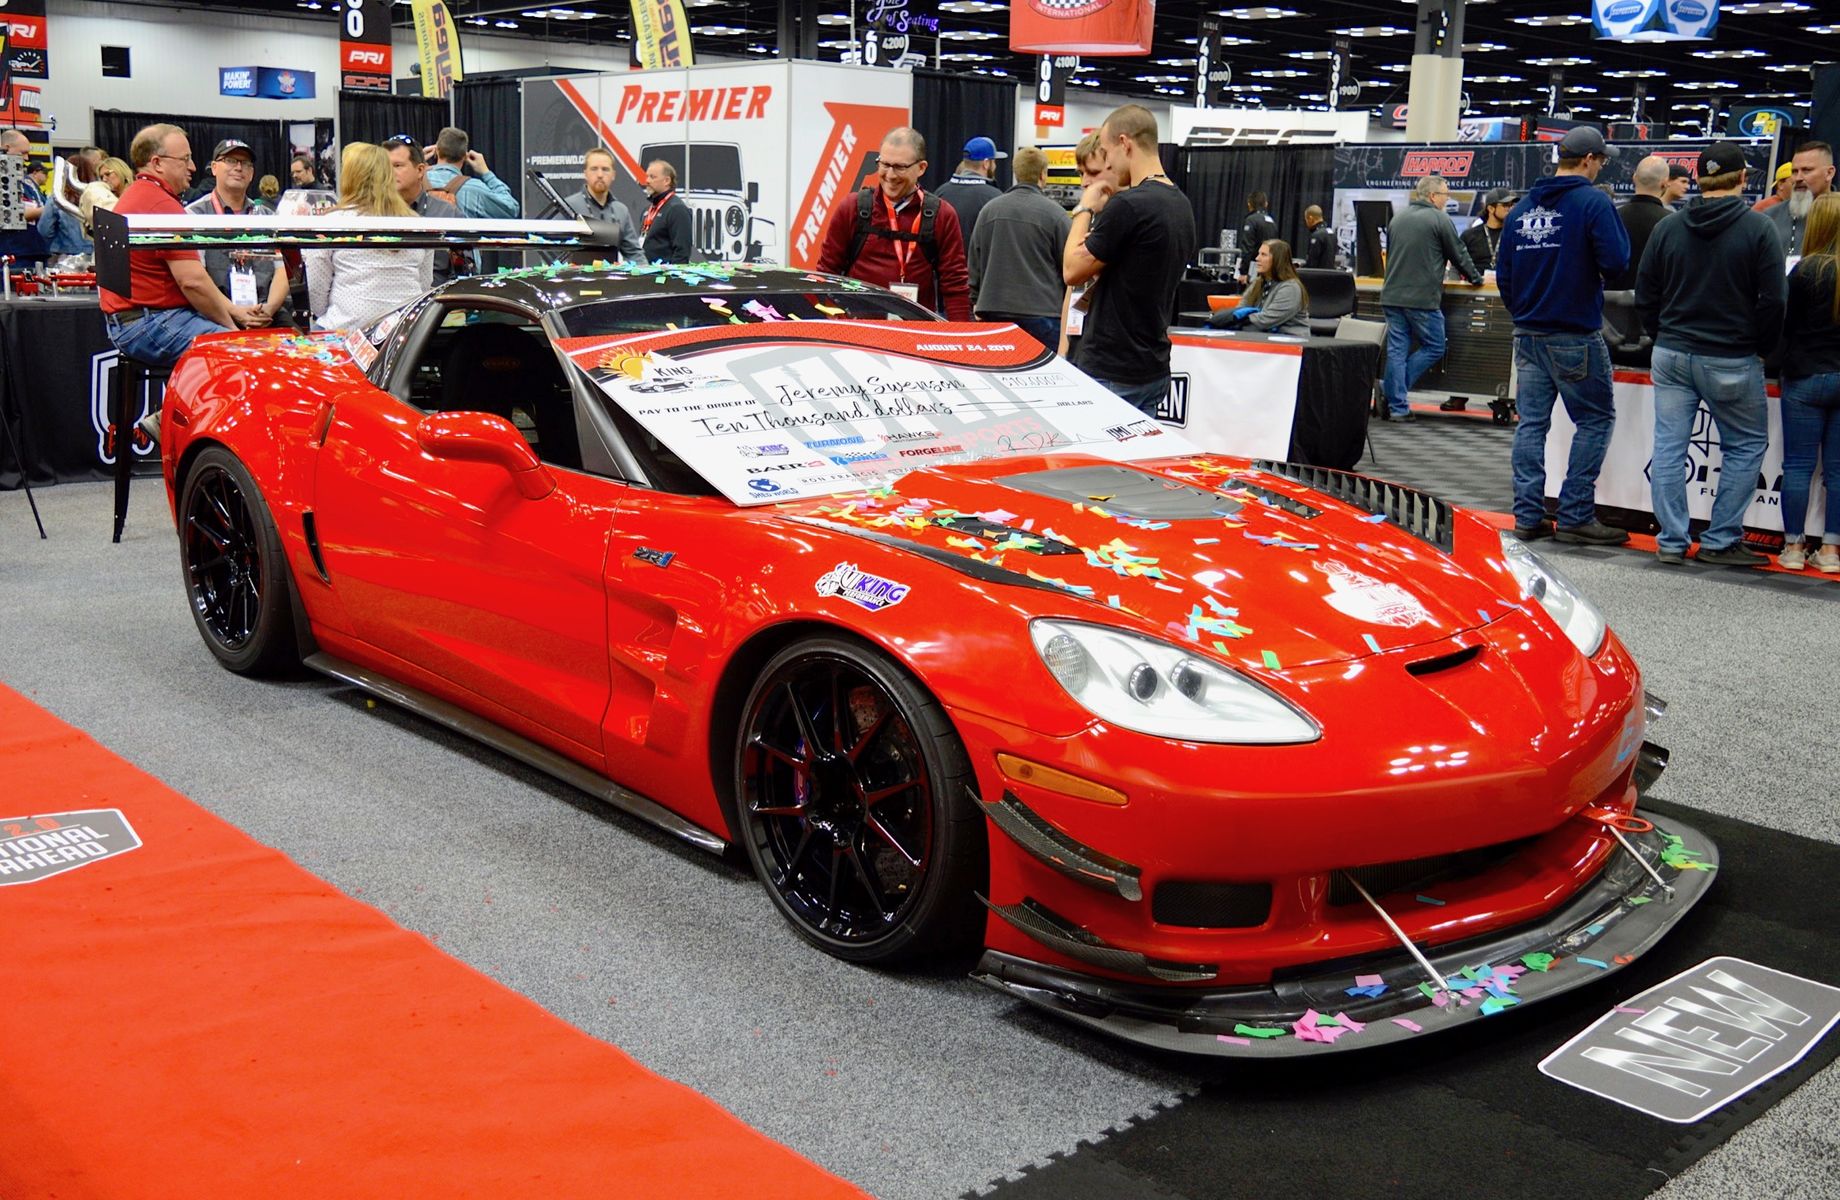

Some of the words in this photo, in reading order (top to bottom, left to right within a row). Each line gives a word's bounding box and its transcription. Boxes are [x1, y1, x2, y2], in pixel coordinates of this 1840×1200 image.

[1036, 2, 1103, 17] INTERNATIONAL
[886, 10, 899, 26] of
[896, 10, 938, 32] Seating
[349, 50, 385, 65] PRI
[1054, 56, 1075, 68] 4100
[1328, 54, 1341, 112] 390
[616, 85, 773, 124] PREMIER
[1039, 111, 1060, 121] PRI
[531, 155, 586, 166] PREMIERWD.C
[1406, 156, 1469, 173] HARROP
[1366, 179, 1412, 187] ENGINEERING
[796, 123, 858, 262] PREMIER
[916, 343, 963, 352] AUGUST
[988, 343, 1016, 352] 2019
[654, 366, 694, 377] KING
[776, 382, 869, 407] Jeremy
[867, 375, 965, 395] Swenson
[682, 404, 705, 412] THE
[707, 400, 743, 409] ORDER
[690, 416, 749, 437] Ten
[746, 401, 869, 431] Thousand
[874, 396, 953, 417] dollars
[1056, 400, 1094, 408] DOLLARS
[899, 445, 963, 457] FORGELINE
[746, 463, 806, 474] BAER
[802, 475, 826, 484] RON
[830, 470, 880, 481] FRANCIS
[841, 571, 906, 602] VIKING
[3, 817, 62, 837] 2.0
[1580, 969, 1812, 1098] NEW
